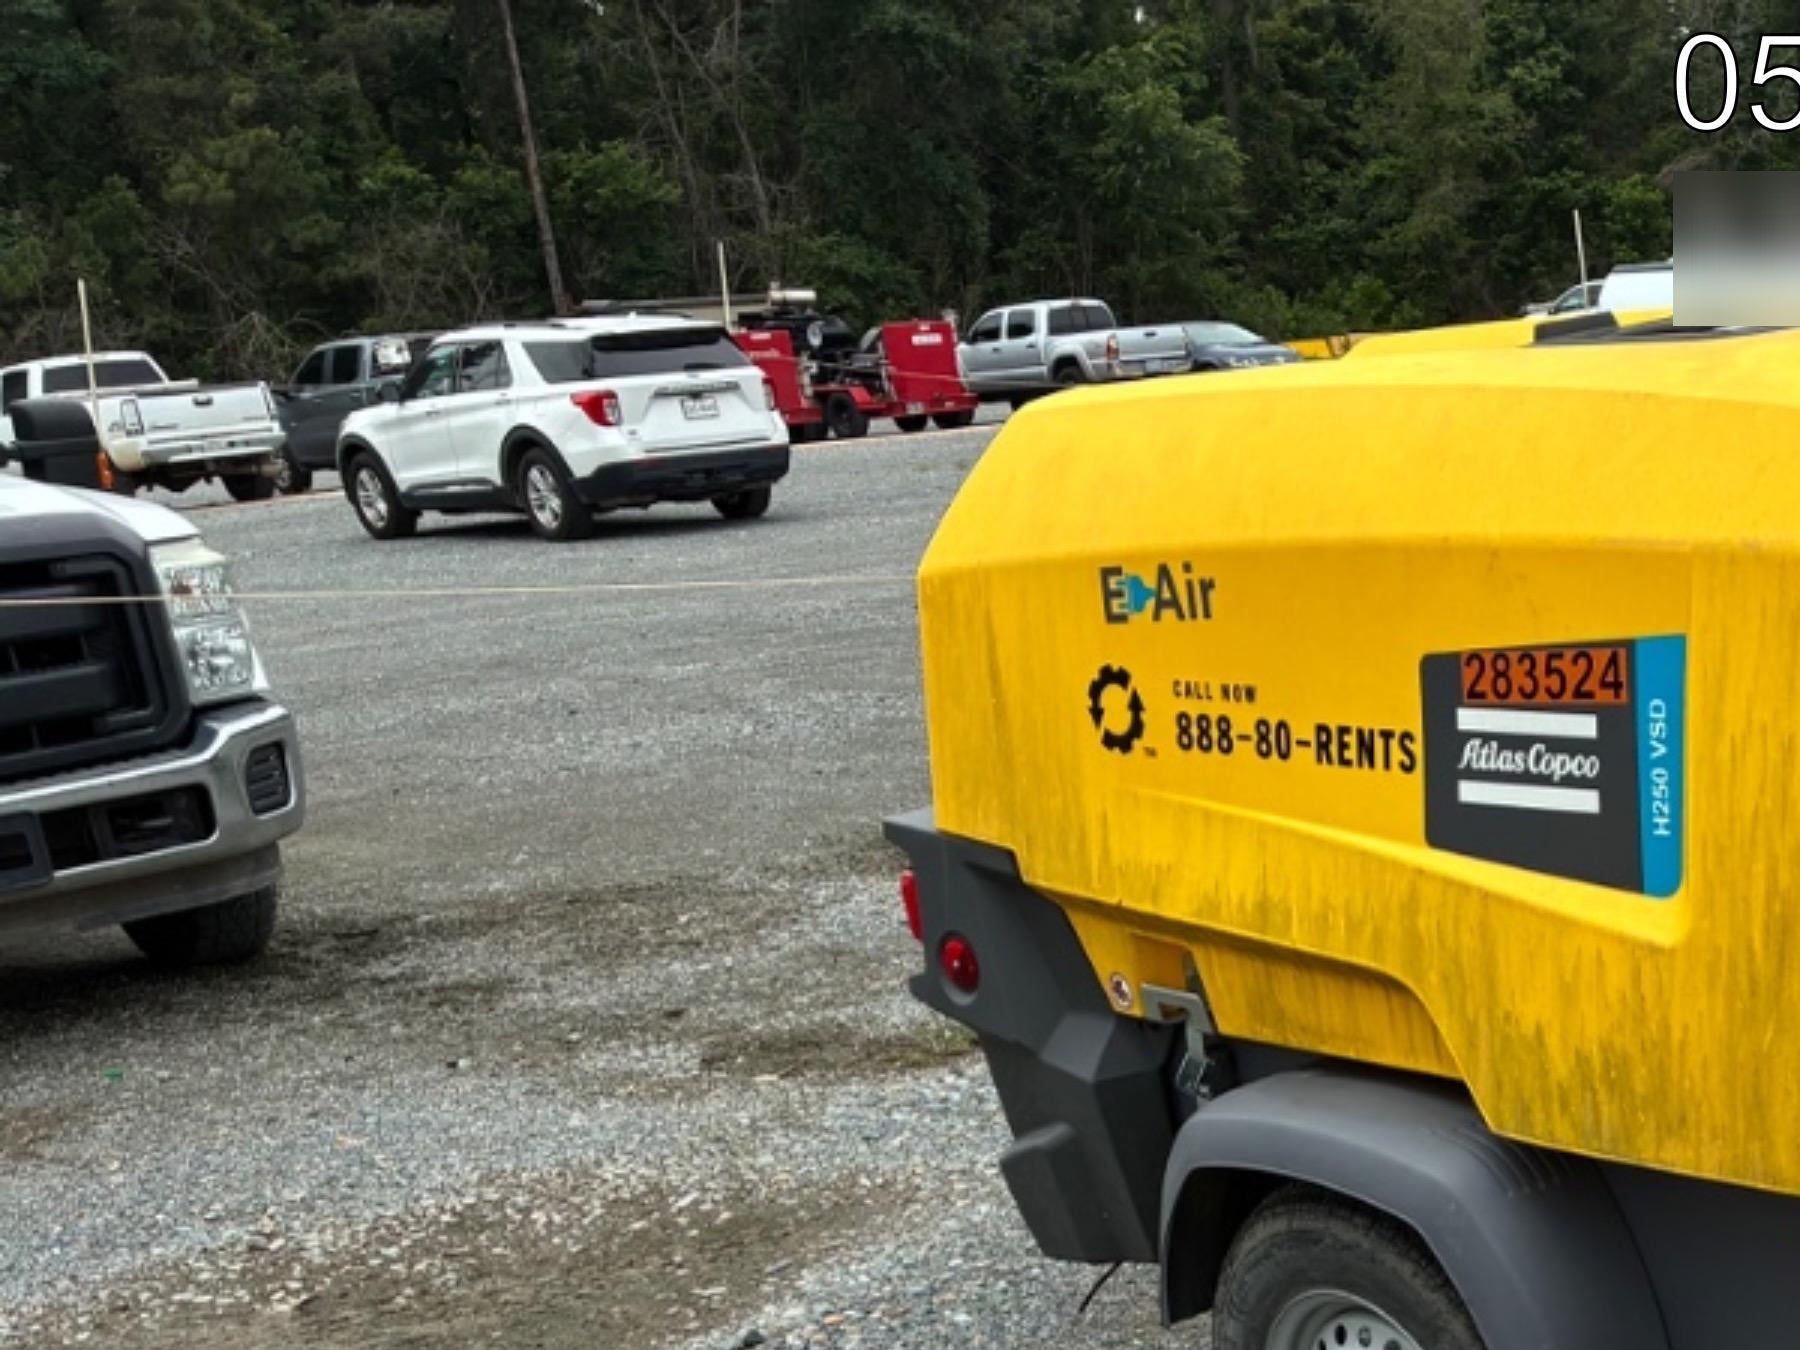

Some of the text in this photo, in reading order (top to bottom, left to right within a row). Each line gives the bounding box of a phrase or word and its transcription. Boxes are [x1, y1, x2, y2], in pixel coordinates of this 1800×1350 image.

[1173, 679, 1257, 703] CALL NOW
[1463, 650, 1624, 700] 283524
[1176, 710, 1416, 774] 888-80-RENTS
[1458, 738, 1600, 783] Atlas Copco
[1649, 698, 1671, 836] H250 VSD
